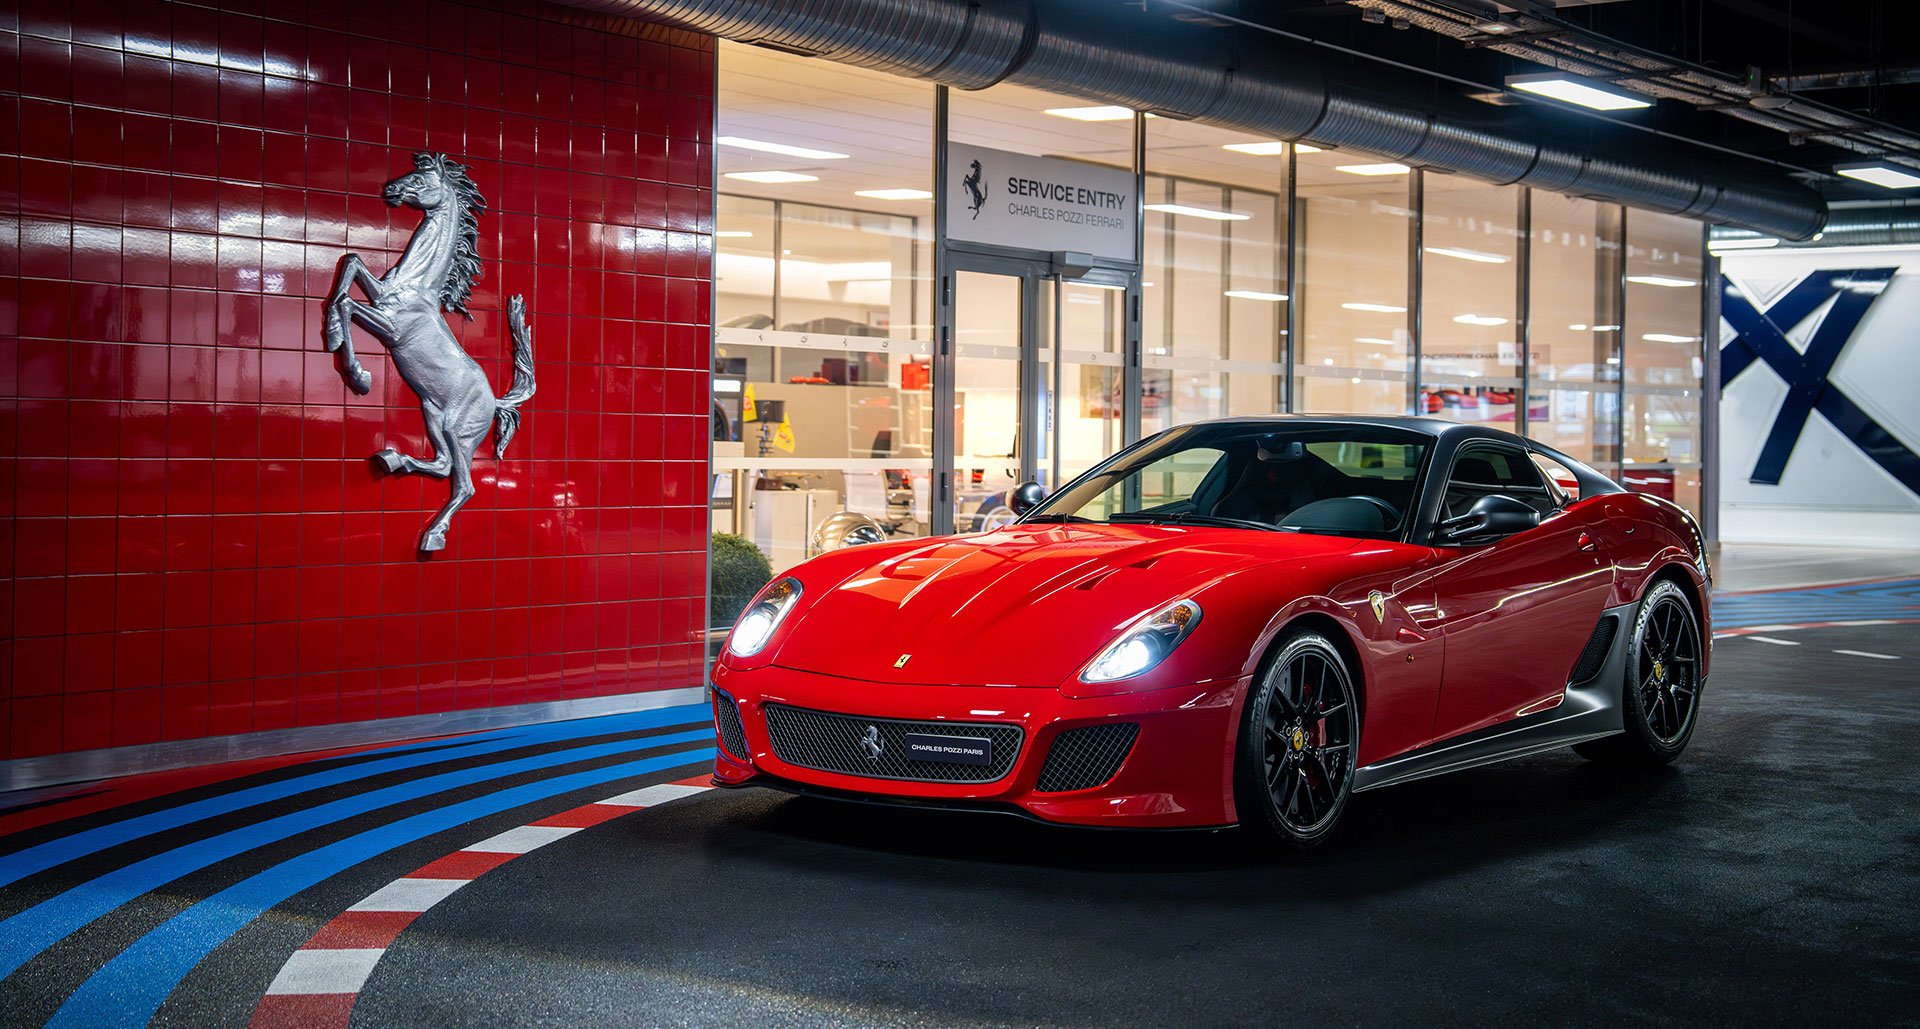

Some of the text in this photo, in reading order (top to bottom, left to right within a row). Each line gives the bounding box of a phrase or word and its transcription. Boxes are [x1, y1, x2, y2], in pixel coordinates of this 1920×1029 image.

[1008, 177, 1126, 210] SERVICE ENTRY
[1008, 203, 1124, 230] CHARLES POZZI FERRARI
[911, 744, 984, 756] CHARLES POZZI PARIS
